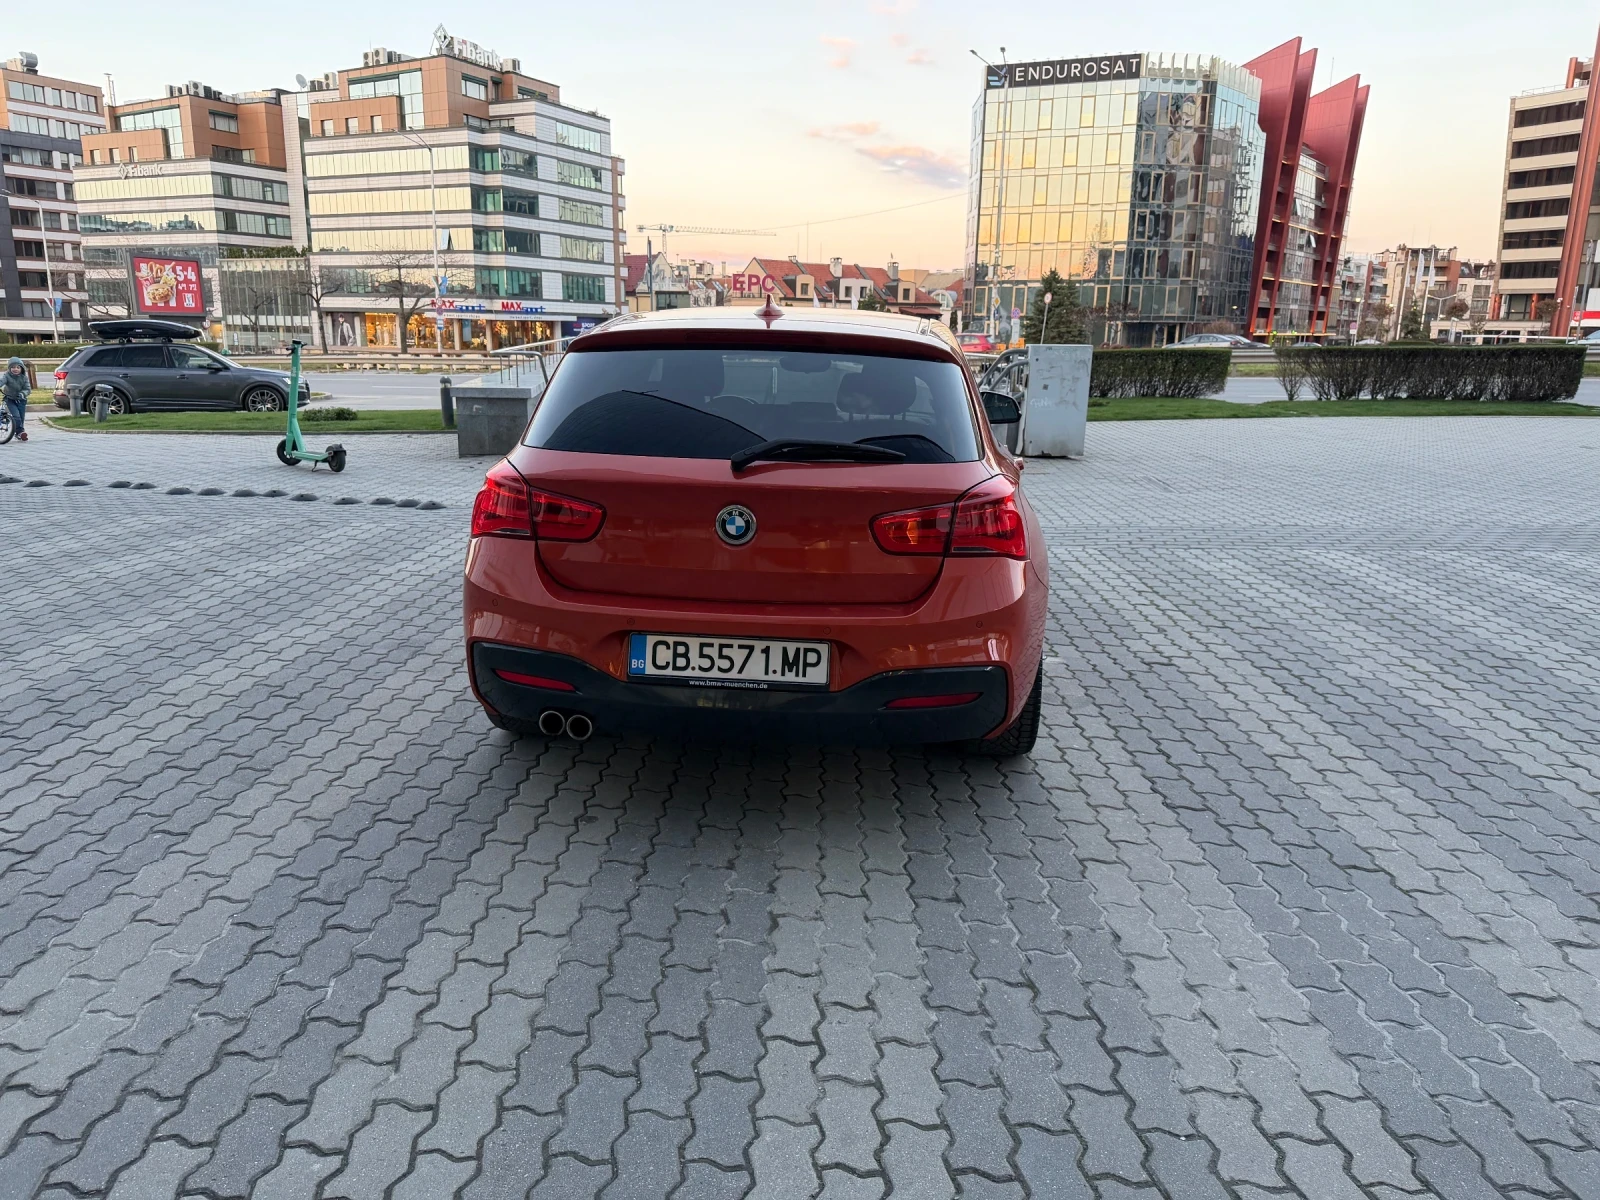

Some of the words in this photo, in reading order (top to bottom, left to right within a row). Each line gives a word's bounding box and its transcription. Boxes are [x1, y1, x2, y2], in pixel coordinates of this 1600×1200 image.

[453, 36, 501, 71] Fibank
[1015, 58, 1140, 82] ENDUROSAT
[127, 163, 163, 177] Fibank
[732, 273, 776, 293] EPC
[501, 301, 522, 311] MAX
[631, 659, 645, 669] BG
[688, 679, 768, 689] www.bmw-muenchen.de
